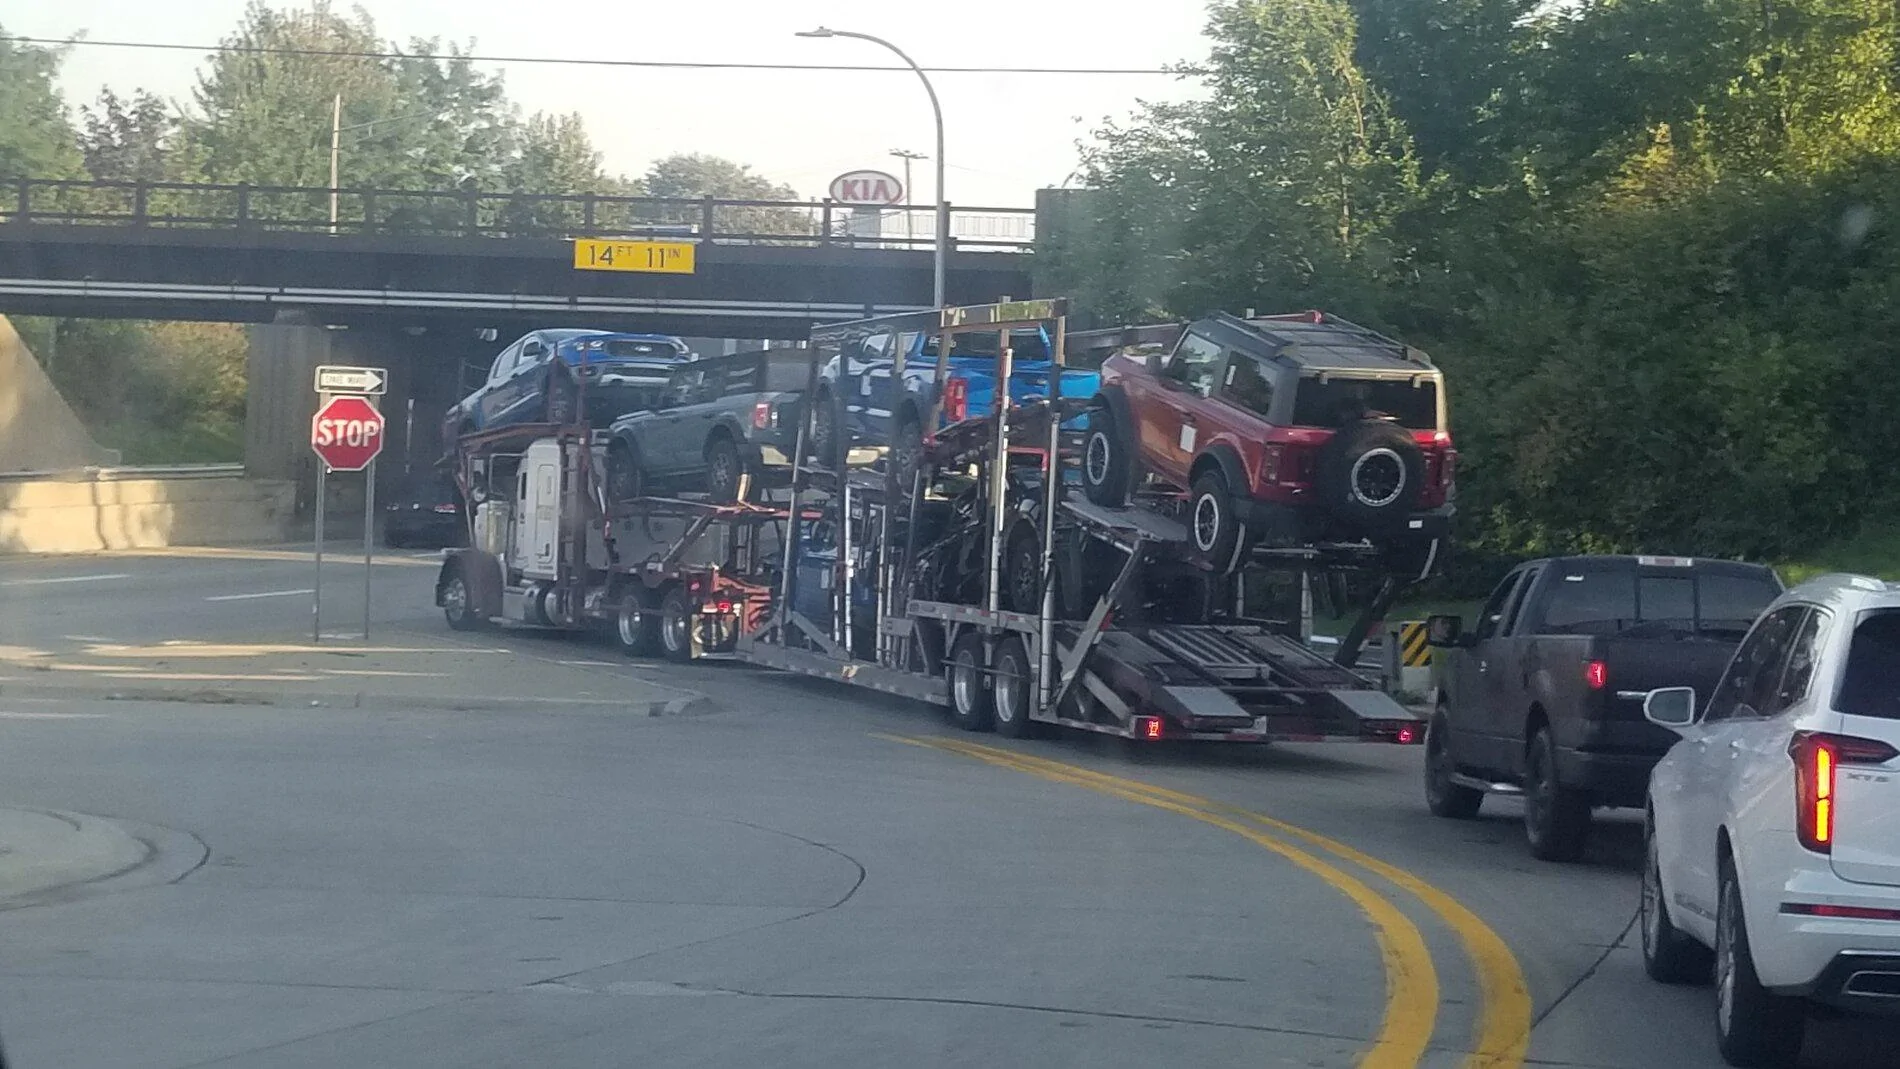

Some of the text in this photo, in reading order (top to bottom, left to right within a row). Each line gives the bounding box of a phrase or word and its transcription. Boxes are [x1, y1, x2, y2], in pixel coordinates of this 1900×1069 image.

[842, 179, 890, 200] KIA
[589, 244, 681, 268] 14 FT 11 IN
[317, 419, 379, 447] STOP
